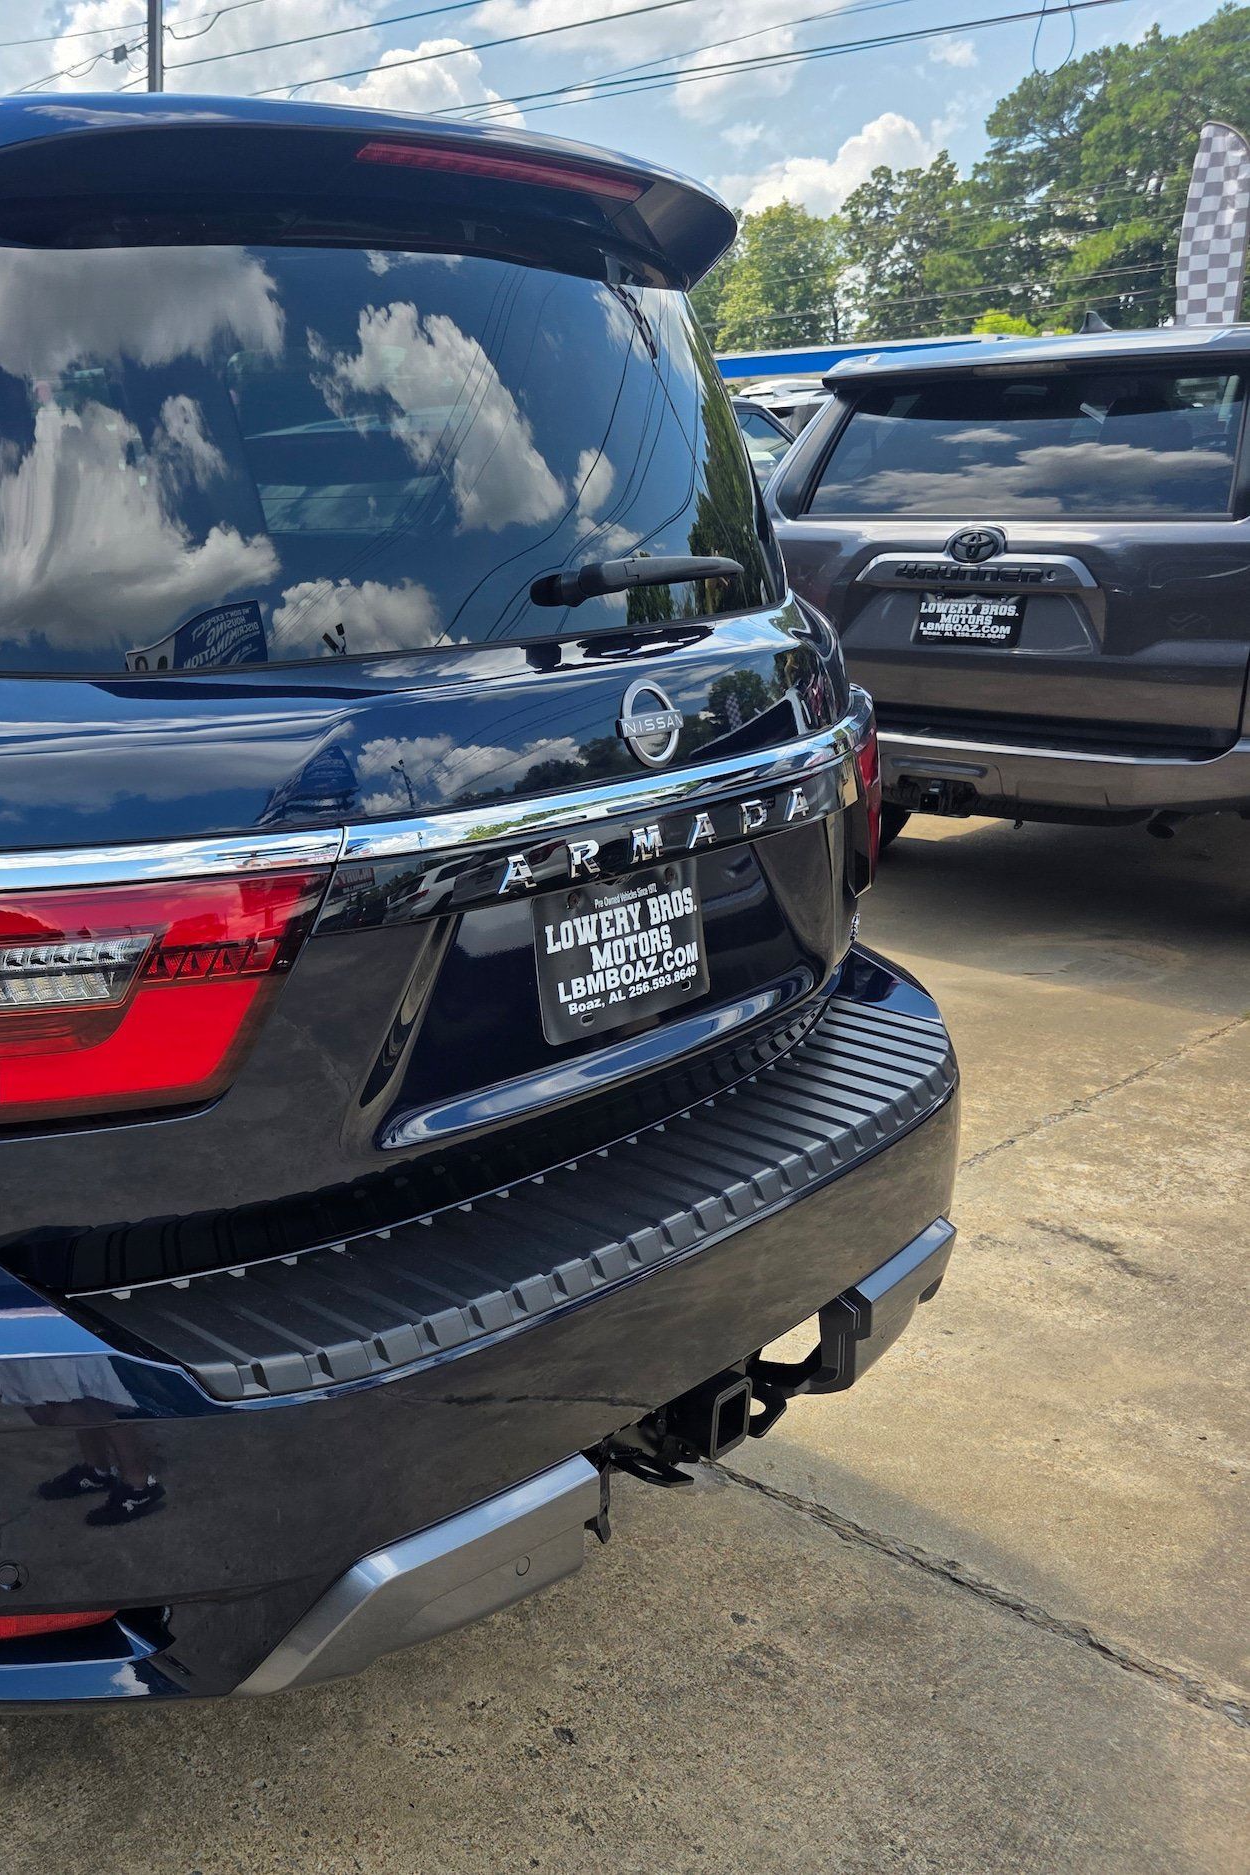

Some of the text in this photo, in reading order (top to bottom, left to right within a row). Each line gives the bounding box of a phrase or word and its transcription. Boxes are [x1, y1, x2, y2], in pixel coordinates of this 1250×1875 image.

[895, 563, 1043, 583] 4RUNNER
[920, 602, 1019, 616] LOWERY BROS.
[939, 614, 993, 625] MOTORS
[624, 712, 683, 735] NISSAN
[498, 787, 810, 895] ARMADA
[545, 886, 697, 955] LOWERY BROS.
[589, 924, 673, 972] MOTORS
[557, 941, 699, 1004] LBMBOAZ.COM
[568, 964, 697, 1016] Boaz, AL 256.593.8649
